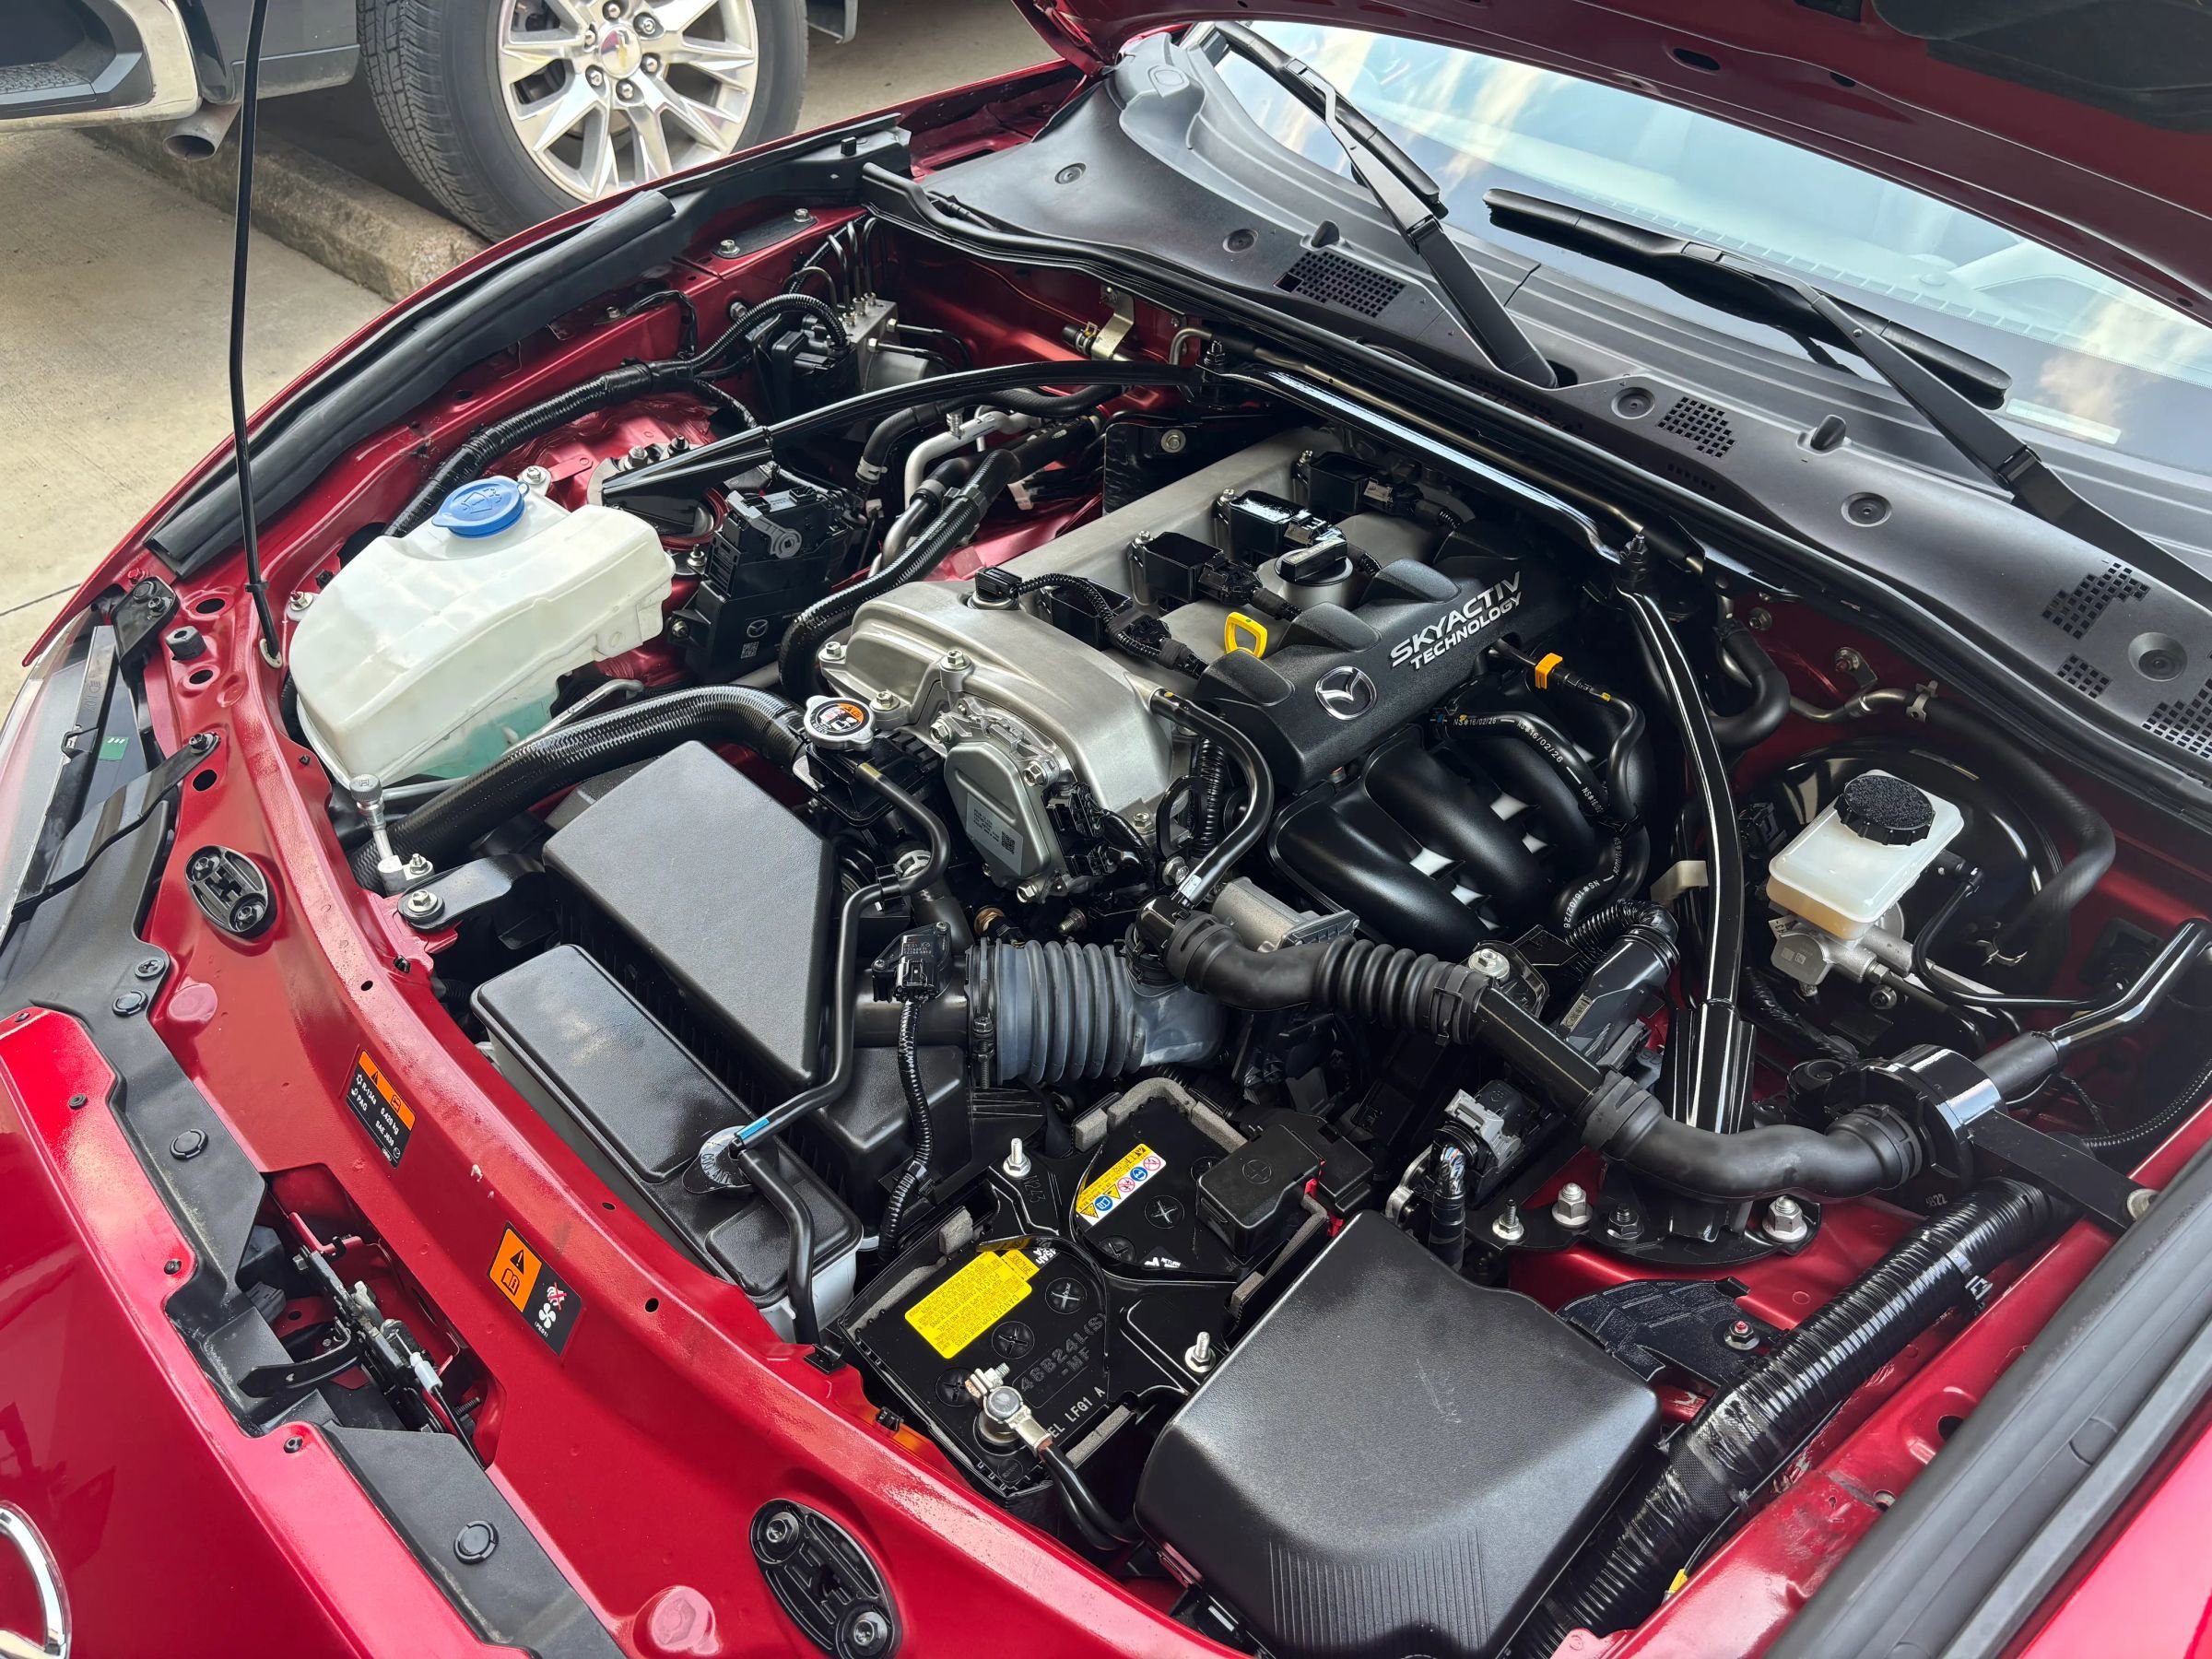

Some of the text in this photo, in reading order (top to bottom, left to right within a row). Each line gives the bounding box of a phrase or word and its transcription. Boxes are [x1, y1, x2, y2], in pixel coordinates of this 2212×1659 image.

[1390, 571, 1520, 667] SKYACTIV
[1410, 592, 1522, 669] TECHNOLOGY
[361, 1082, 377, 1105] R-134a
[356, 1094, 368, 1112] PAG
[375, 1120, 385, 1135] SAE
[974, 1271, 1000, 1292] POISON
[989, 1293, 1019, 1319] DANGER
[1094, 1386, 1105, 1397] A
